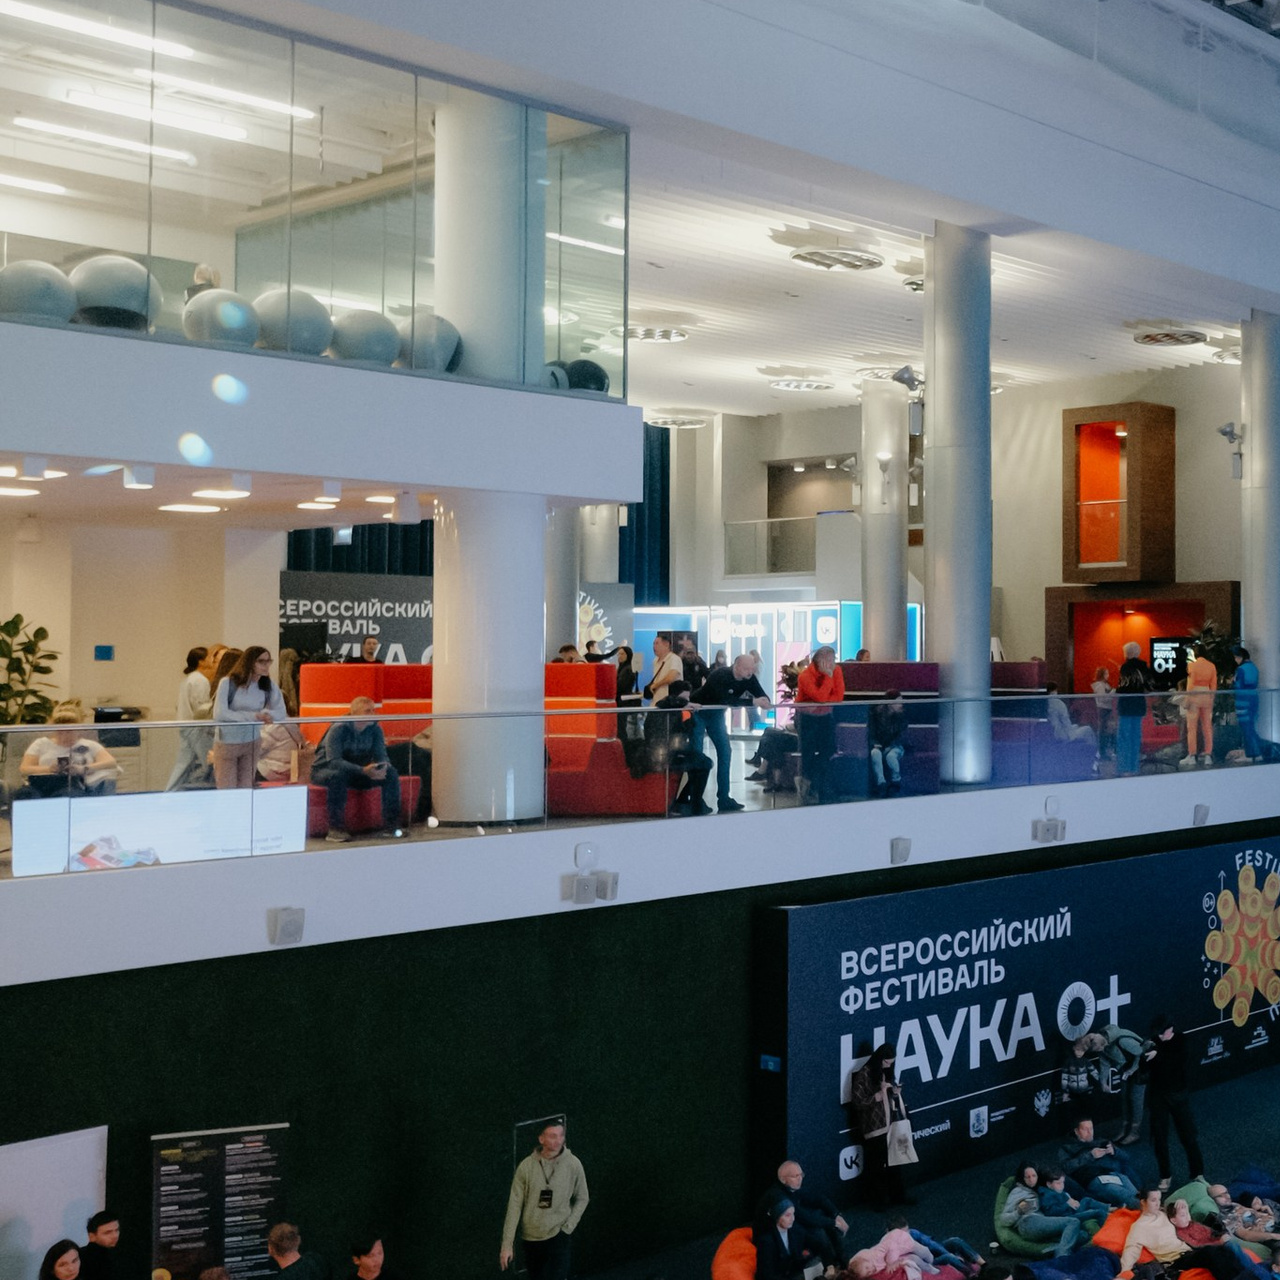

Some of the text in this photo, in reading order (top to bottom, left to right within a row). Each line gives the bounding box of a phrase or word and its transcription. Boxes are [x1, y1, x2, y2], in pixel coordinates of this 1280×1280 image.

[840, 906, 1072, 980] ВСЕРОССИЙСКИЙ
[839, 957, 1006, 1015] ФЕСТИВАЛЬ
[840, 992, 1045, 1105] НАУКА
